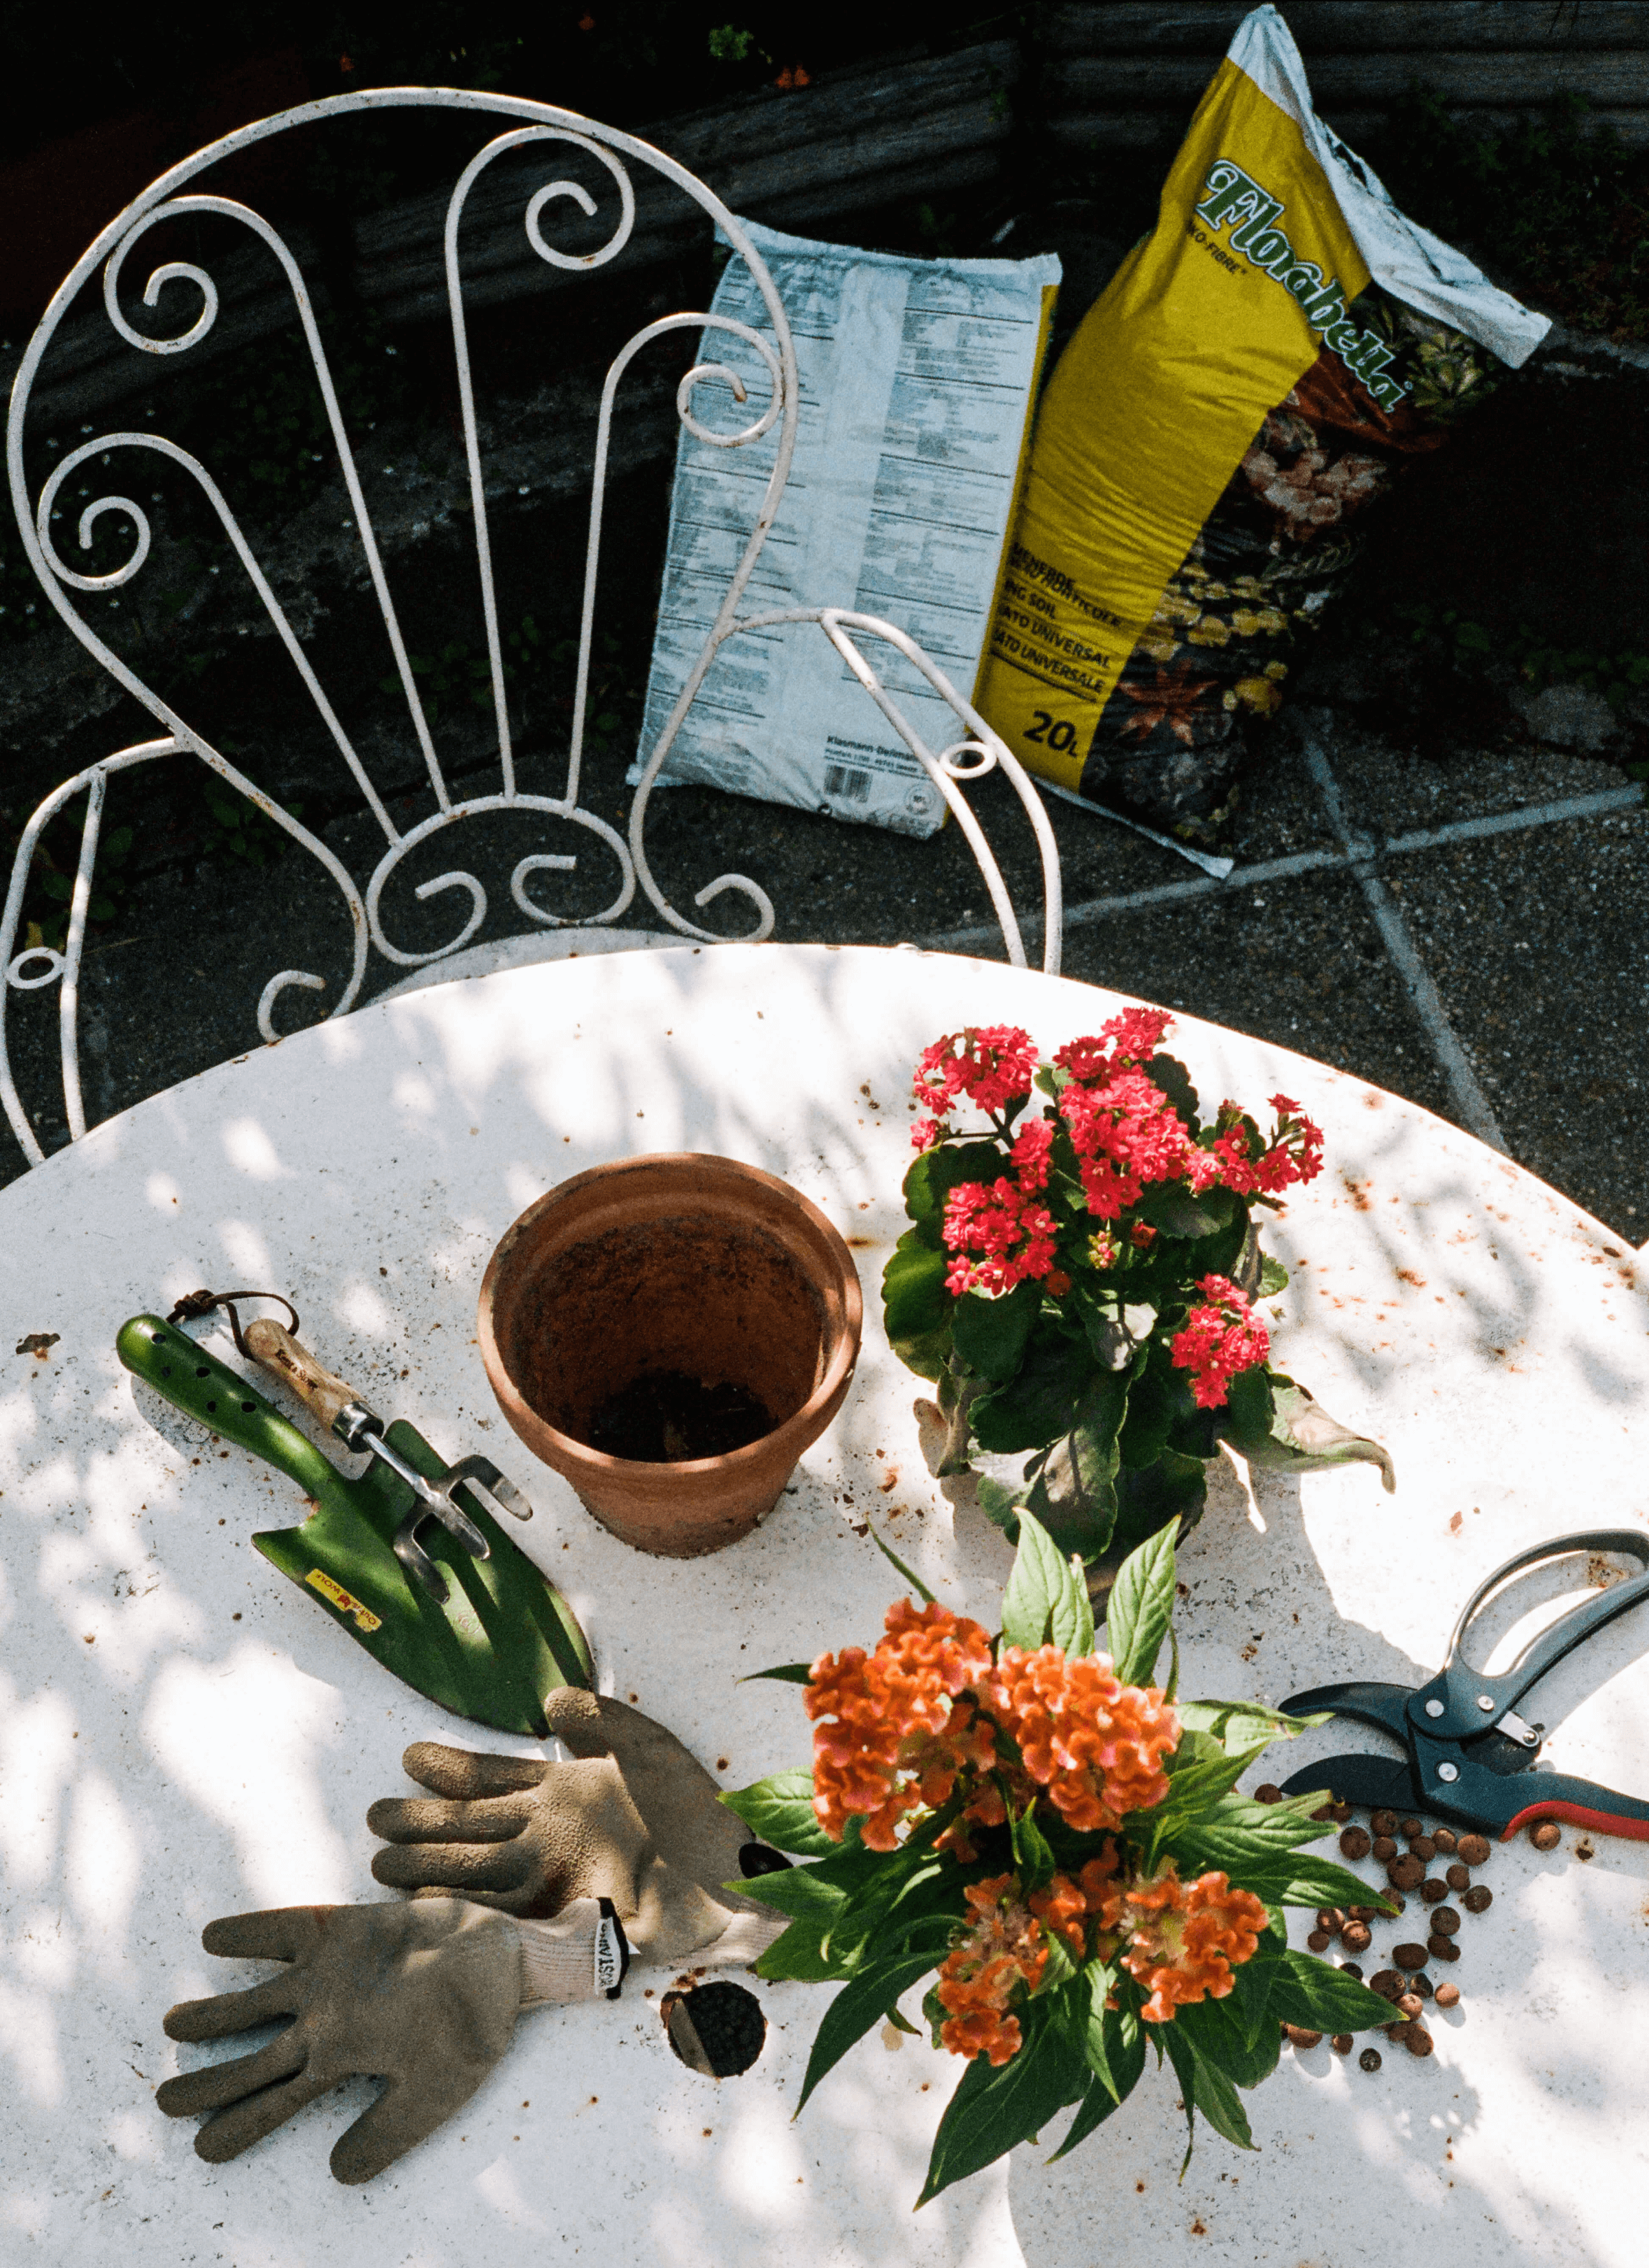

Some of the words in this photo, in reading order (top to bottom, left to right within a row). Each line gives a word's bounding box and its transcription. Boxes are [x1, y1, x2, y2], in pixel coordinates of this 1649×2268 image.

[1195, 159, 1407, 414] Florabella
[1029, 593, 1057, 620] SOIL
[1020, 644, 1106, 693] UNIVERSALE
[1031, 620, 1111, 669] UNIVERSAL
[315, 1573, 341, 1594] WOLF
